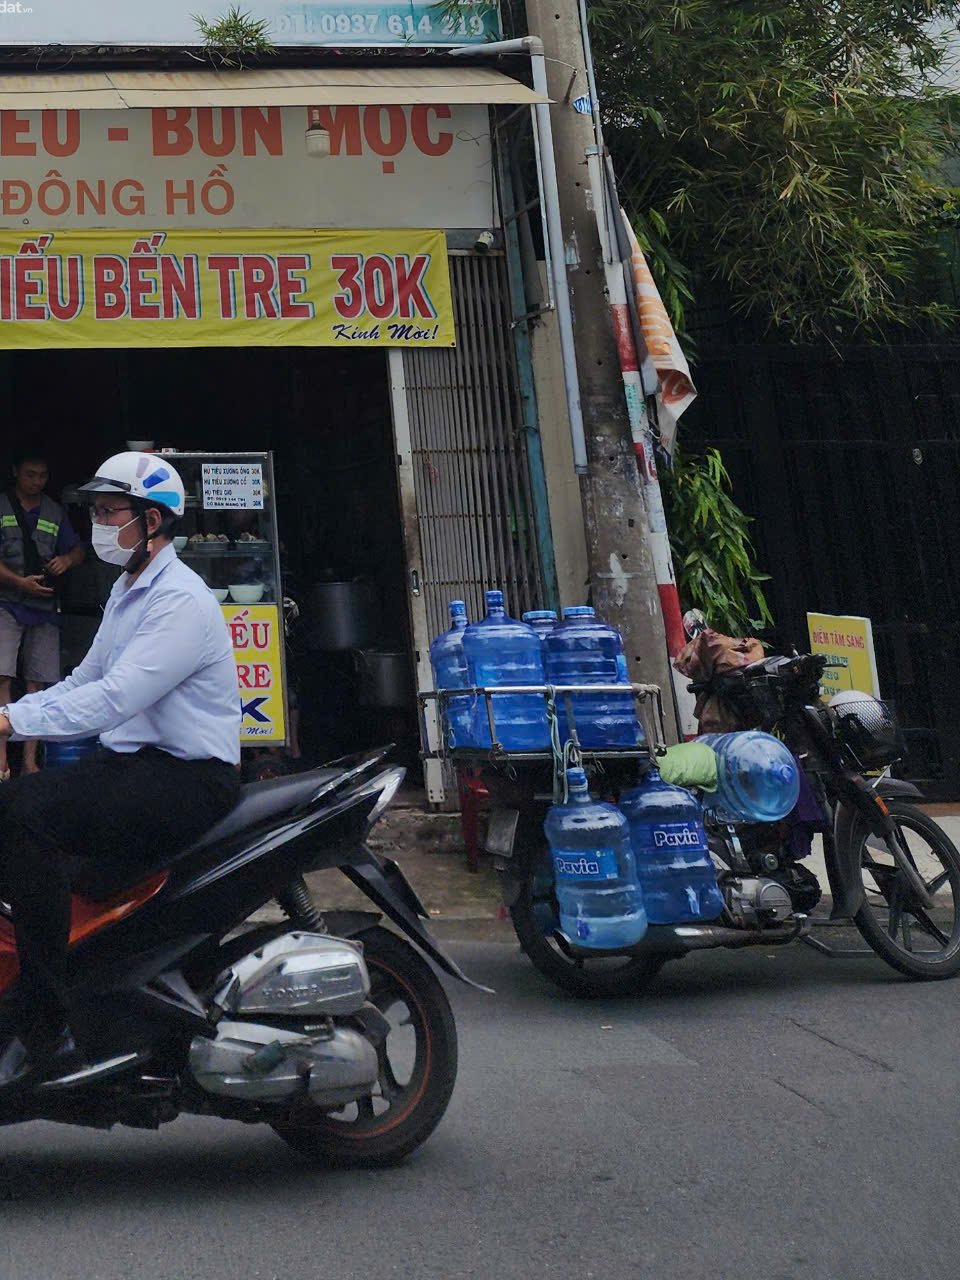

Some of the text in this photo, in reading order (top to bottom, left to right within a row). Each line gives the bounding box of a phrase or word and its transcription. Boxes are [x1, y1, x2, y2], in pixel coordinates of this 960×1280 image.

[321, 14, 379, 35] 0937
[388, 14, 433, 35] 614
[0, 163, 235, 216] ĐÔNG HỒ
[93, 232, 201, 320] BẾN
[207, 253, 315, 320] TRE
[330, 253, 439, 320] 30K
[330, 323, 439, 340] Kính Mời!
[236, 664, 272, 688] RE
[654, 827, 700, 847] Pavia
[556, 856, 599, 875] Pavia
